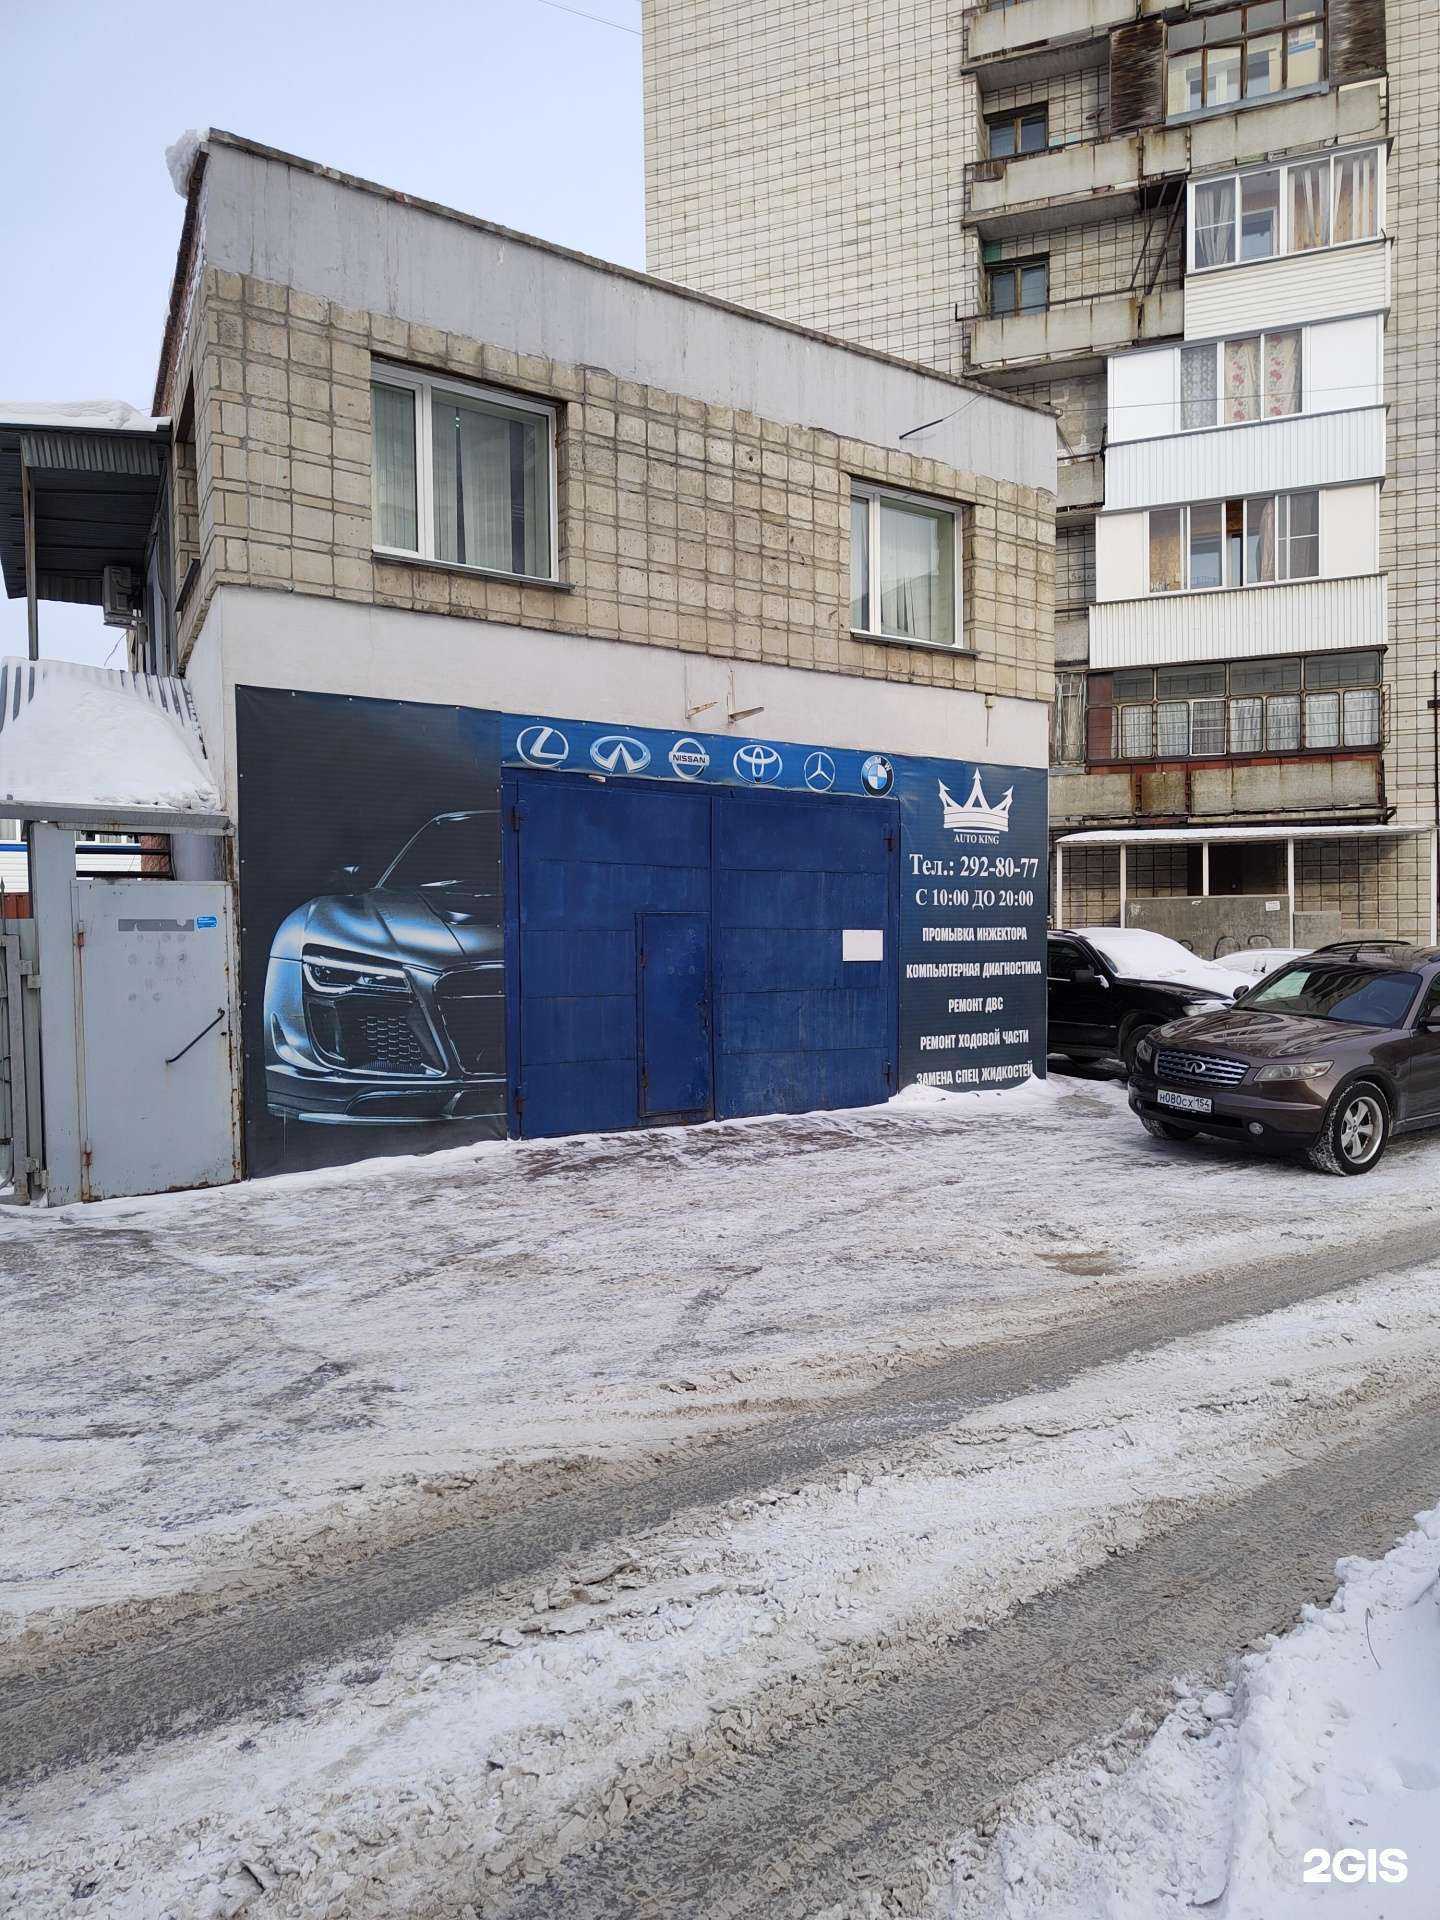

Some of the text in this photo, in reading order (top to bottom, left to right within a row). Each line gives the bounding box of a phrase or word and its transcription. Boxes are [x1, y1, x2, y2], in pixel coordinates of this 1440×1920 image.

[672, 754, 706, 764] NISSAN
[954, 833, 1000, 845] AUTO KING
[909, 853, 1039, 879] Тел.: 292-80-77
[915, 888, 1034, 910] С 10:00 ДО 20:00
[922, 926, 1028, 942] ПРОМЫВКА ИНЖЕКТОРА
[906, 960, 1042, 979] КОМПЬЮТЕРНАЯ ДИАГНОСТИКА
[948, 996, 1004, 1014] РЕМОНТ ДВС
[919, 1027, 1030, 1051] РЕМОНТ ХОДОВОЙ ЧАСТИ
[916, 1060, 1034, 1087] ЗАМЕНА СПЕЦ ЖИДКОСТЕЙ
